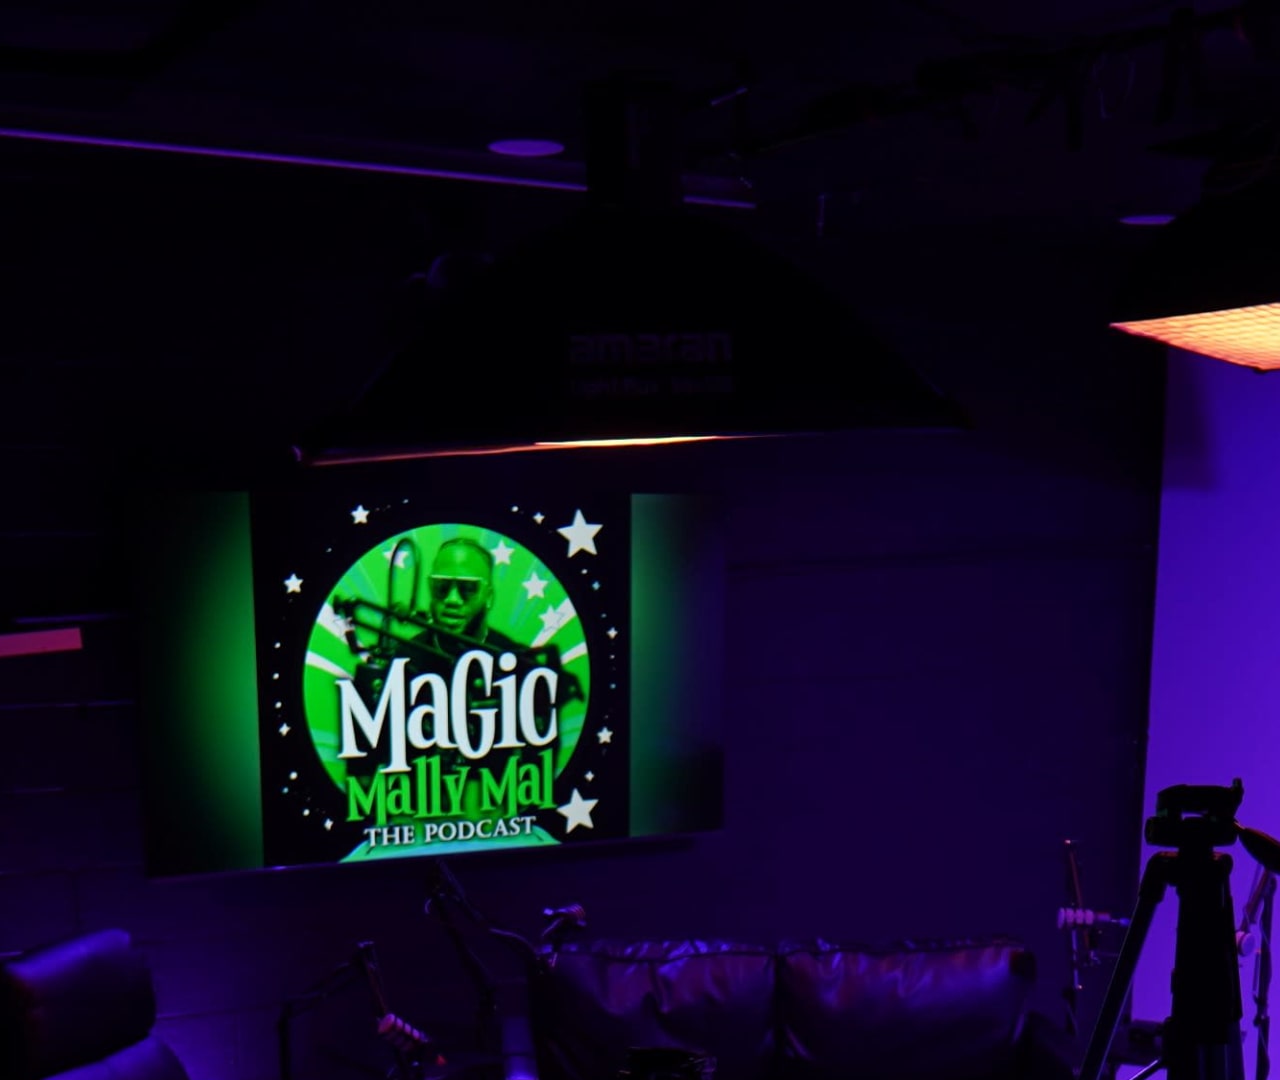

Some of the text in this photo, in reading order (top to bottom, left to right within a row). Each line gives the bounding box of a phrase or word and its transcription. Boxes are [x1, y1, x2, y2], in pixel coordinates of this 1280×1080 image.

[479, 748, 558, 820] Mal
[363, 816, 537, 847] THE PODCAST
